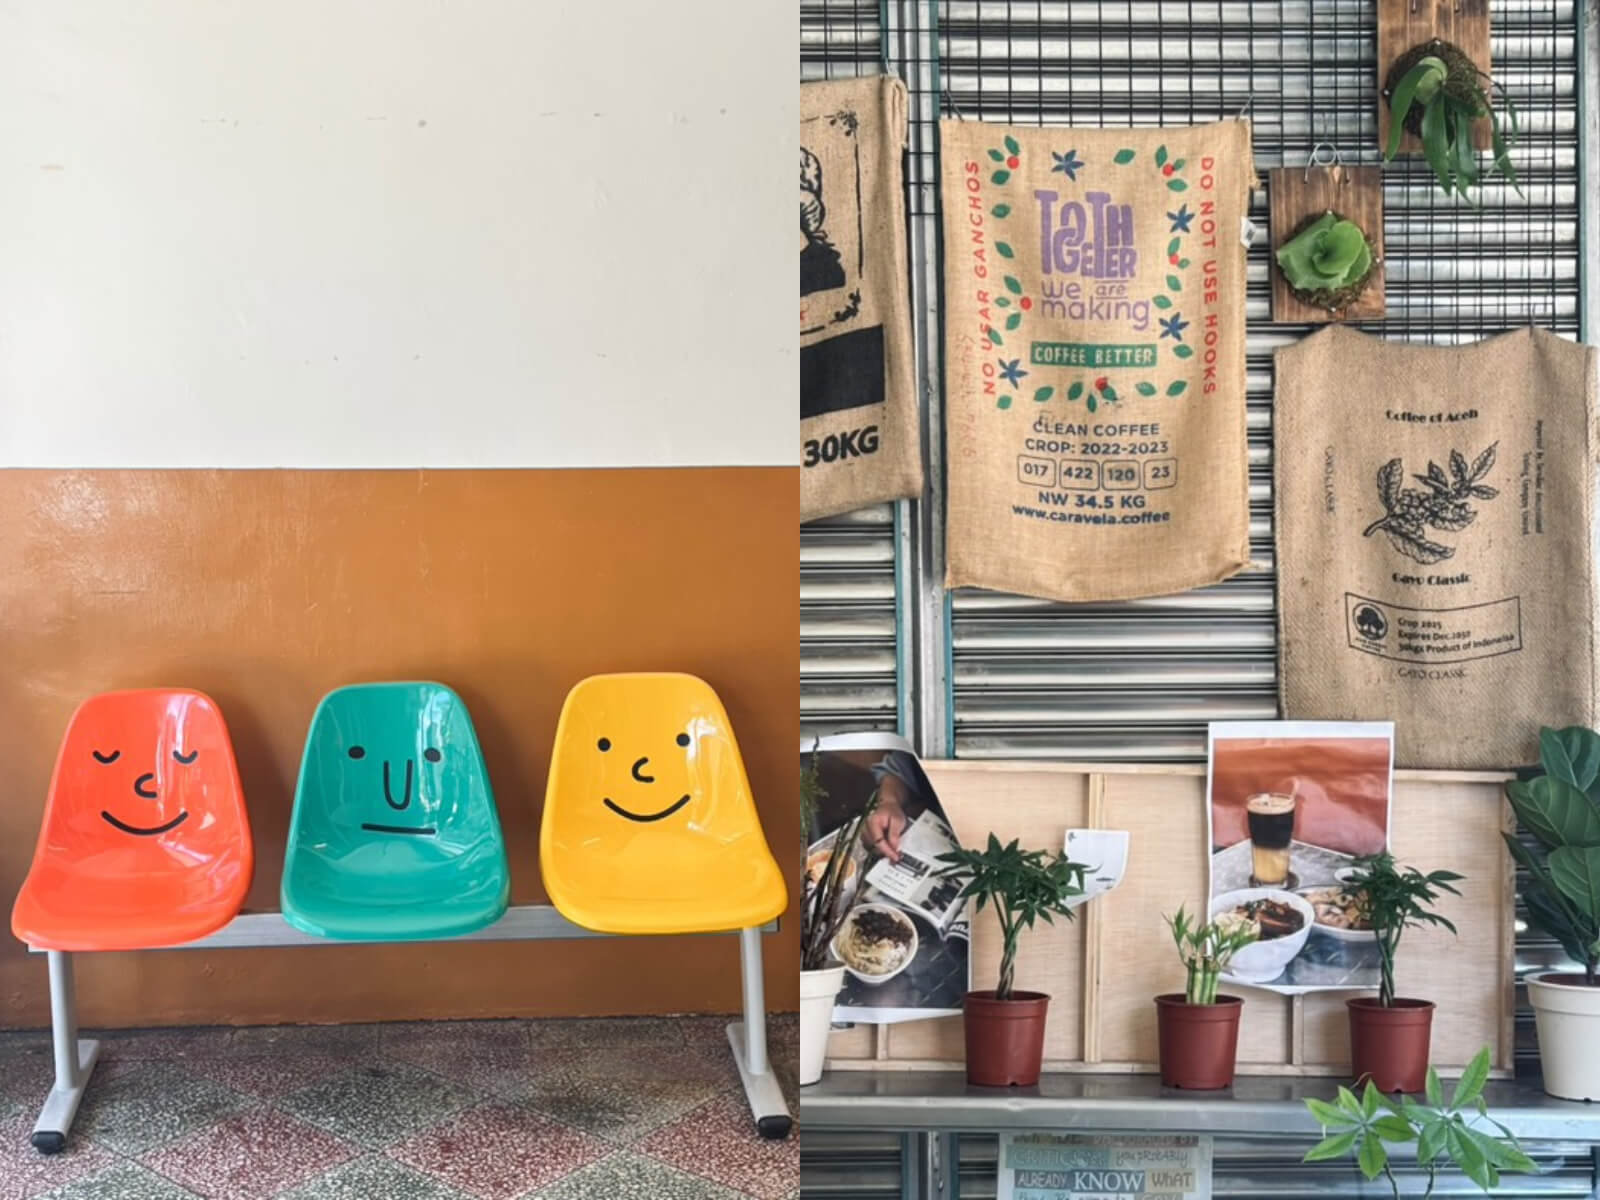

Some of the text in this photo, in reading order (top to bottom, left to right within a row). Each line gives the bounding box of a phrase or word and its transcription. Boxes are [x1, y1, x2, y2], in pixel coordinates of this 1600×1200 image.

[965, 161, 996, 395] NO USAR GANCHOS
[1200, 156, 1218, 395] DO NOT USE HOOKS
[1095, 282, 1128, 298] are
[1040, 296, 1150, 331] making
[1034, 346, 1154, 366] COFFEE BETTER
[1429, 412, 1443, 423] of
[1032, 421, 1161, 437] CLEAN COFFEE
[803, 424, 879, 468] 30KG
[1025, 438, 1169, 456] CROP: 2022-2023
[1023, 462, 1049, 477] 017
[1063, 466, 1093, 480] 422
[1107, 468, 1136, 482] 120
[1151, 466, 1171, 479] 23
[1038, 491, 1146, 509] NW 34.5 KG
[1012, 504, 1171, 526] www.caravela.coffee
[1397, 617, 1419, 629] Crop
[1397, 629, 1431, 642] Expires
[1426, 643, 1460, 654] Product
[1462, 640, 1472, 650] of
[1017, 1171, 1068, 1188] ALREADY
[1074, 1171, 1145, 1191] KNOW
